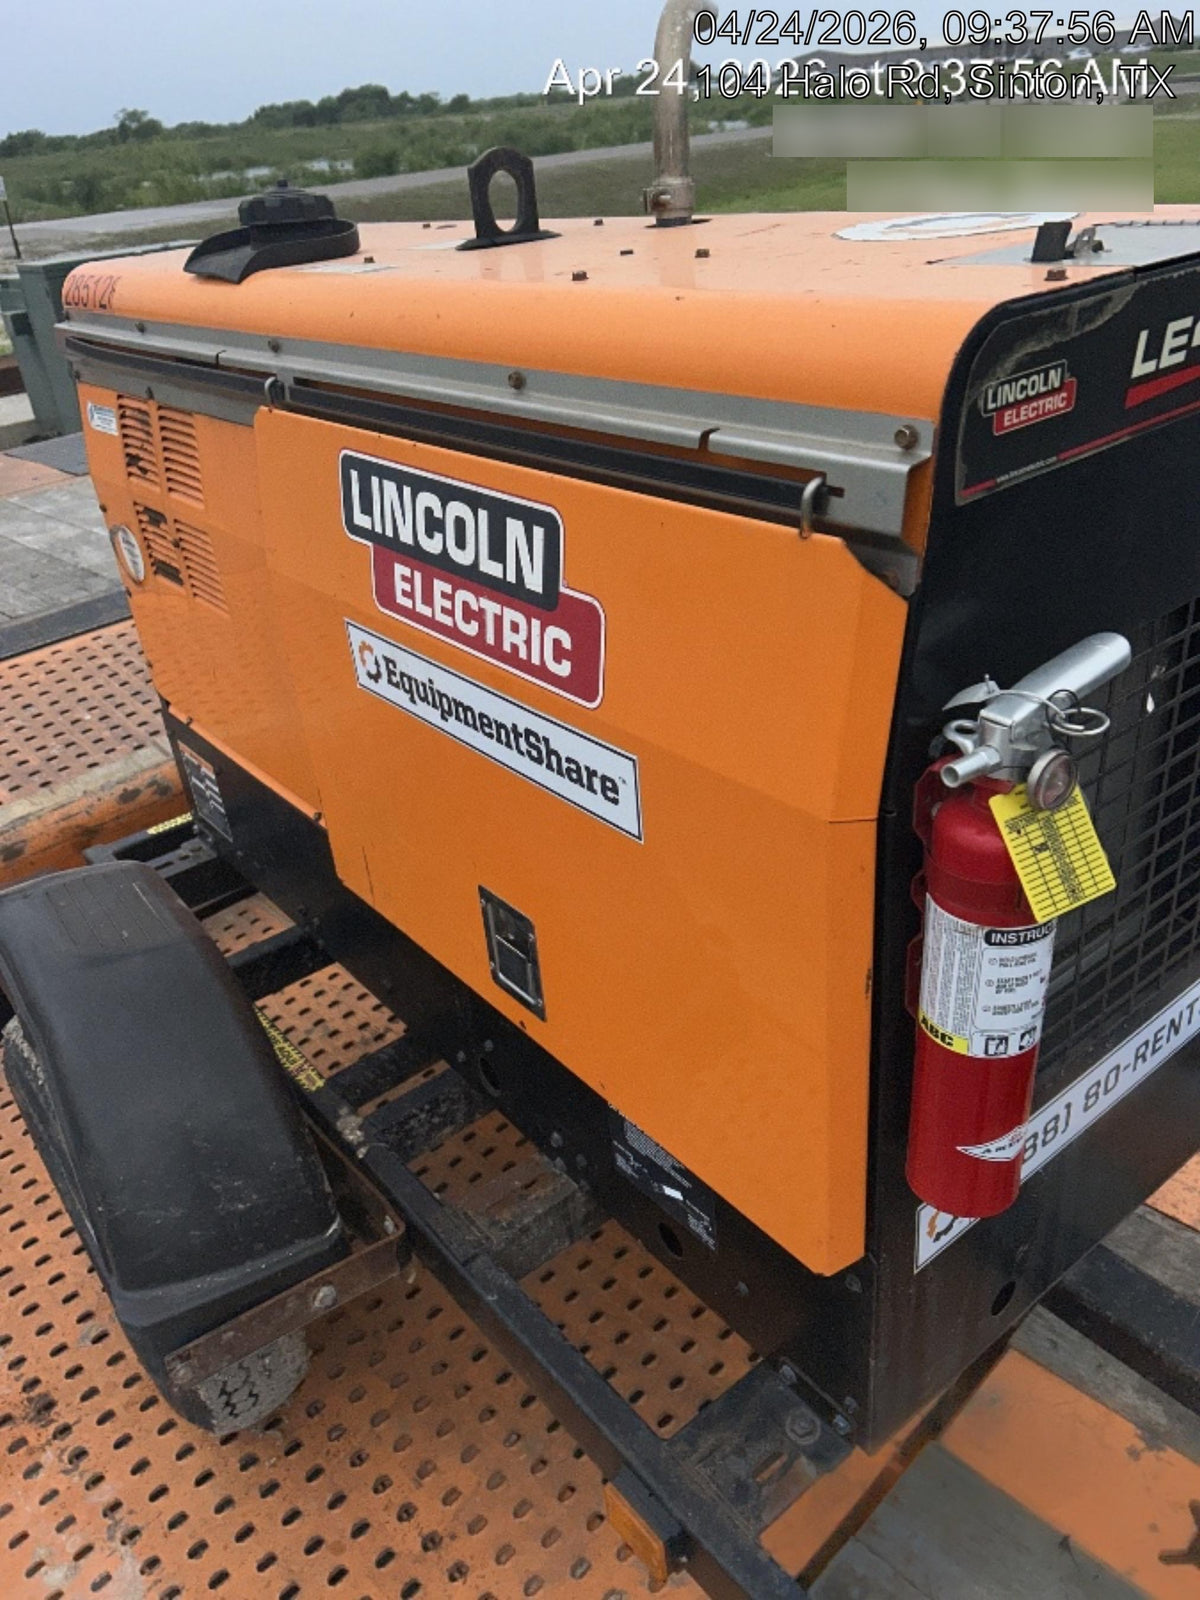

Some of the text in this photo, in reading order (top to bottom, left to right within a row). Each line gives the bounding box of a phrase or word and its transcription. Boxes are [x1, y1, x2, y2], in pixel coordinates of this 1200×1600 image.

[987, 367, 1062, 410] LINCOLN
[1003, 392, 1067, 427] ELECTRIC
[350, 469, 545, 594] LINCOLN
[394, 562, 571, 677] ELECTRIC
[383, 653, 620, 806] EquipmentShare
[921, 1014, 954, 1047] ABC
[1083, 997, 1200, 1113] 80-RENT
